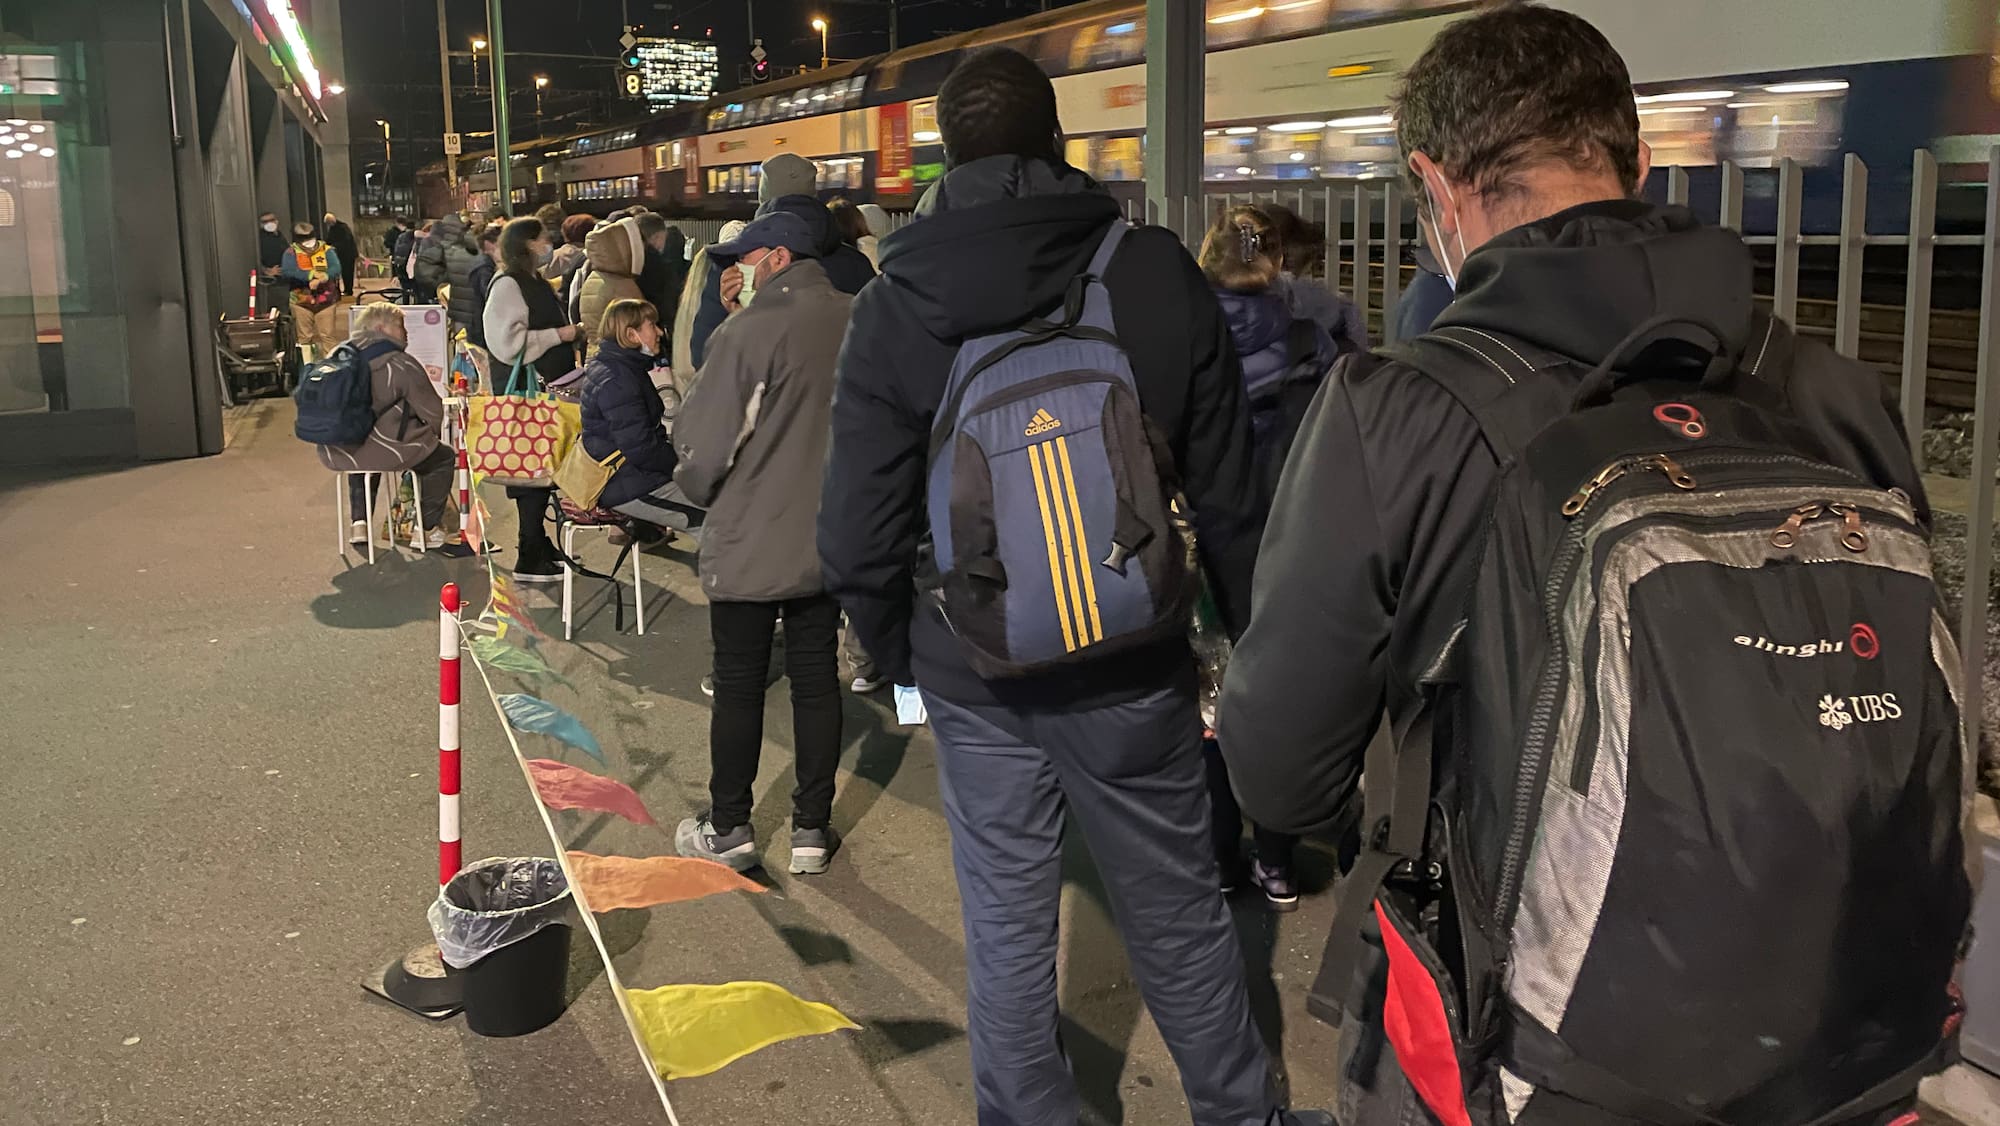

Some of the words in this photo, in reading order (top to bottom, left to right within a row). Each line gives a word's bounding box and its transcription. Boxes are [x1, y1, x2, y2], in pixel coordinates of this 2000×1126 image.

[626, 74, 640, 95] 8
[447, 135, 458, 145] 10
[1024, 419, 1061, 437] adidas
[1733, 635, 1844, 658] alinghi
[1848, 693, 1902, 722] UBS
